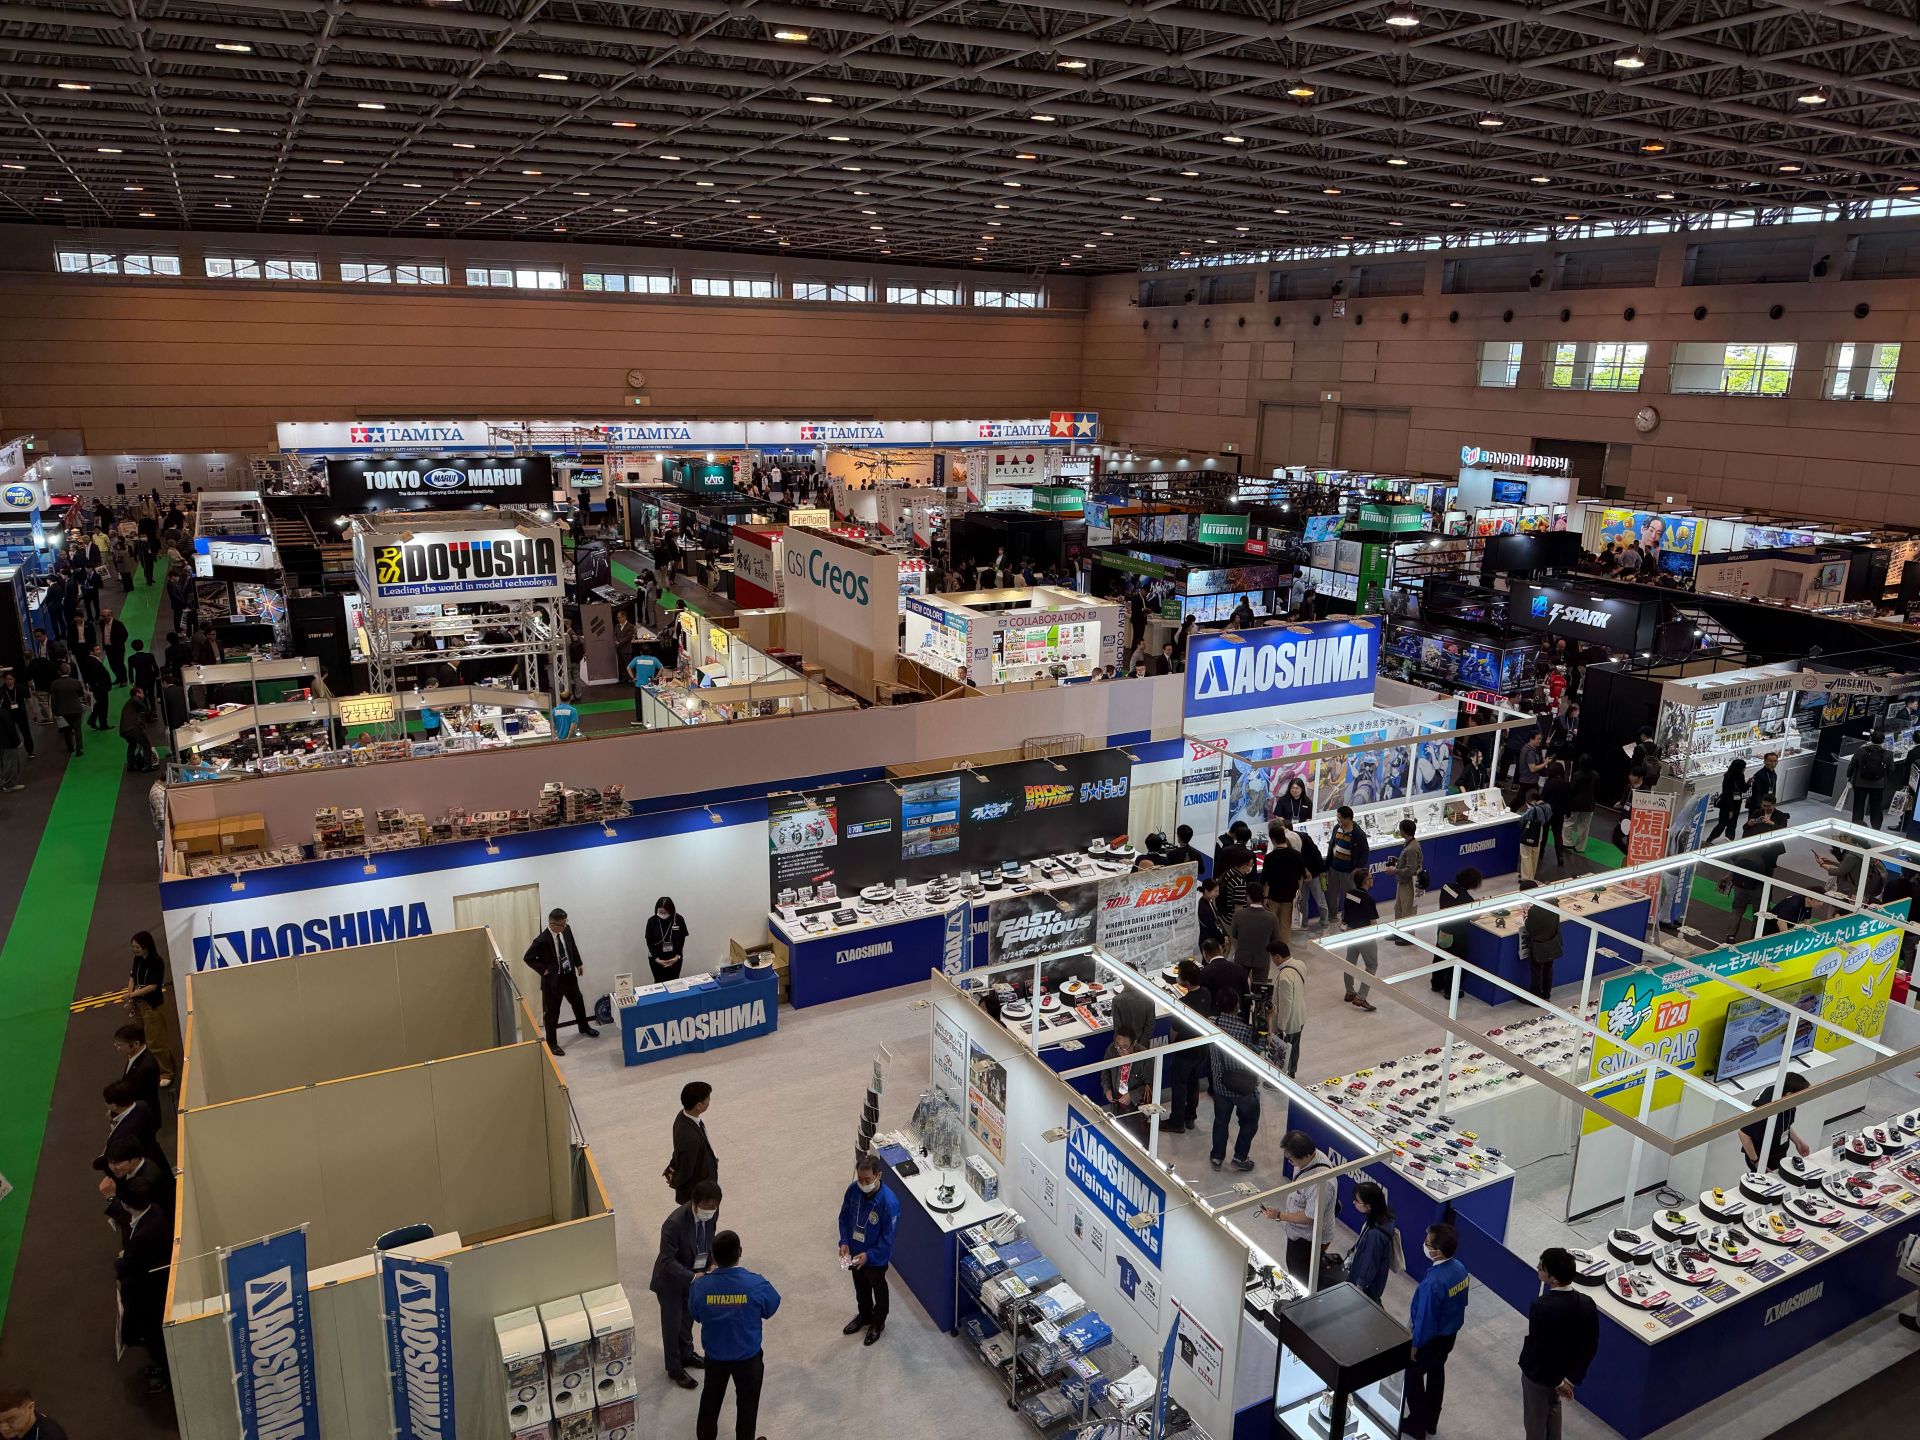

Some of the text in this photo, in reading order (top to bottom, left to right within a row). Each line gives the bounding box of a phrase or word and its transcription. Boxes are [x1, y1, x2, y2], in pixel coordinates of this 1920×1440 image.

[386, 427, 464, 441] TAMIYA
[624, 427, 691, 440] TAMIYA
[827, 427, 885, 439] TAMIYA
[1480, 450, 1525, 466] BANDAI
[363, 468, 522, 489] TOKYO MARUI MARUI
[704, 474, 725, 484] KATO
[995, 467, 1034, 475] PLATZ
[13, 496, 31, 505] JOE
[1202, 522, 1243, 536] KOTOBUKIYA
[404, 538, 557, 582] DOYUSHA
[383, 576, 555, 596] Leading the world in model technology.
[787, 550, 806, 579] GSI
[809, 549, 869, 606] Creos
[911, 601, 923, 613] NEW
[923, 606, 943, 622] COLORS
[1009, 612, 1086, 627] COLLABORATION
[1118, 605, 1126, 628] NEW
[1548, 603, 1612, 629] T-SPARK
[966, 619, 974, 681] COLLABORATI
[1232, 634, 1369, 696] AOSHIMA
[1723, 687, 1743, 699] GIRLS,
[1744, 684, 1757, 695] GET
[1757, 681, 1773, 693] YOUR
[1024, 785, 1066, 799] BACK
[1034, 793, 1074, 809] FUTURE
[1465, 837, 1496, 854] AOSHIMA
[1102, 895, 1131, 911] 30th
[1157, 910, 1171, 919] CIVIC
[1172, 908, 1183, 916] TYPE
[250, 902, 433, 965] AOSHIMA
[996, 909, 1056, 938] FAST
[1052, 912, 1062, 922] &
[1001, 915, 1093, 950] FURIOUS
[1104, 930, 1128, 940] AKIYAMA
[849, 940, 894, 962] AOSHIMA
[1002, 947, 1041, 960] 1/24スケール
[1703, 925, 1856, 974] カーモデルにチャレンジしたい
[665, 999, 767, 1048] AOSHIMA
[1608, 998, 1653, 1036] 楽プラ
[1657, 1003, 1688, 1030] 1/24
[1657, 1028, 1699, 1065] CAR
[1083, 1127, 1161, 1229] AOSHIMA
[1068, 1154, 1115, 1210] Original
[1116, 1198, 1159, 1255] Gds
[706, 1294, 748, 1305] MIYAZAWA
[1776, 1281, 1825, 1319] AOSHIMA
[438, 1307, 447, 1334] TOTAL
[296, 1294, 312, 1407] TOTAL HOBBY CREATION
[440, 1340, 448, 1369] HOBBY
[248, 1307, 306, 1440] AOSHIMA
[398, 1305, 443, 1440] AOSHIMA
